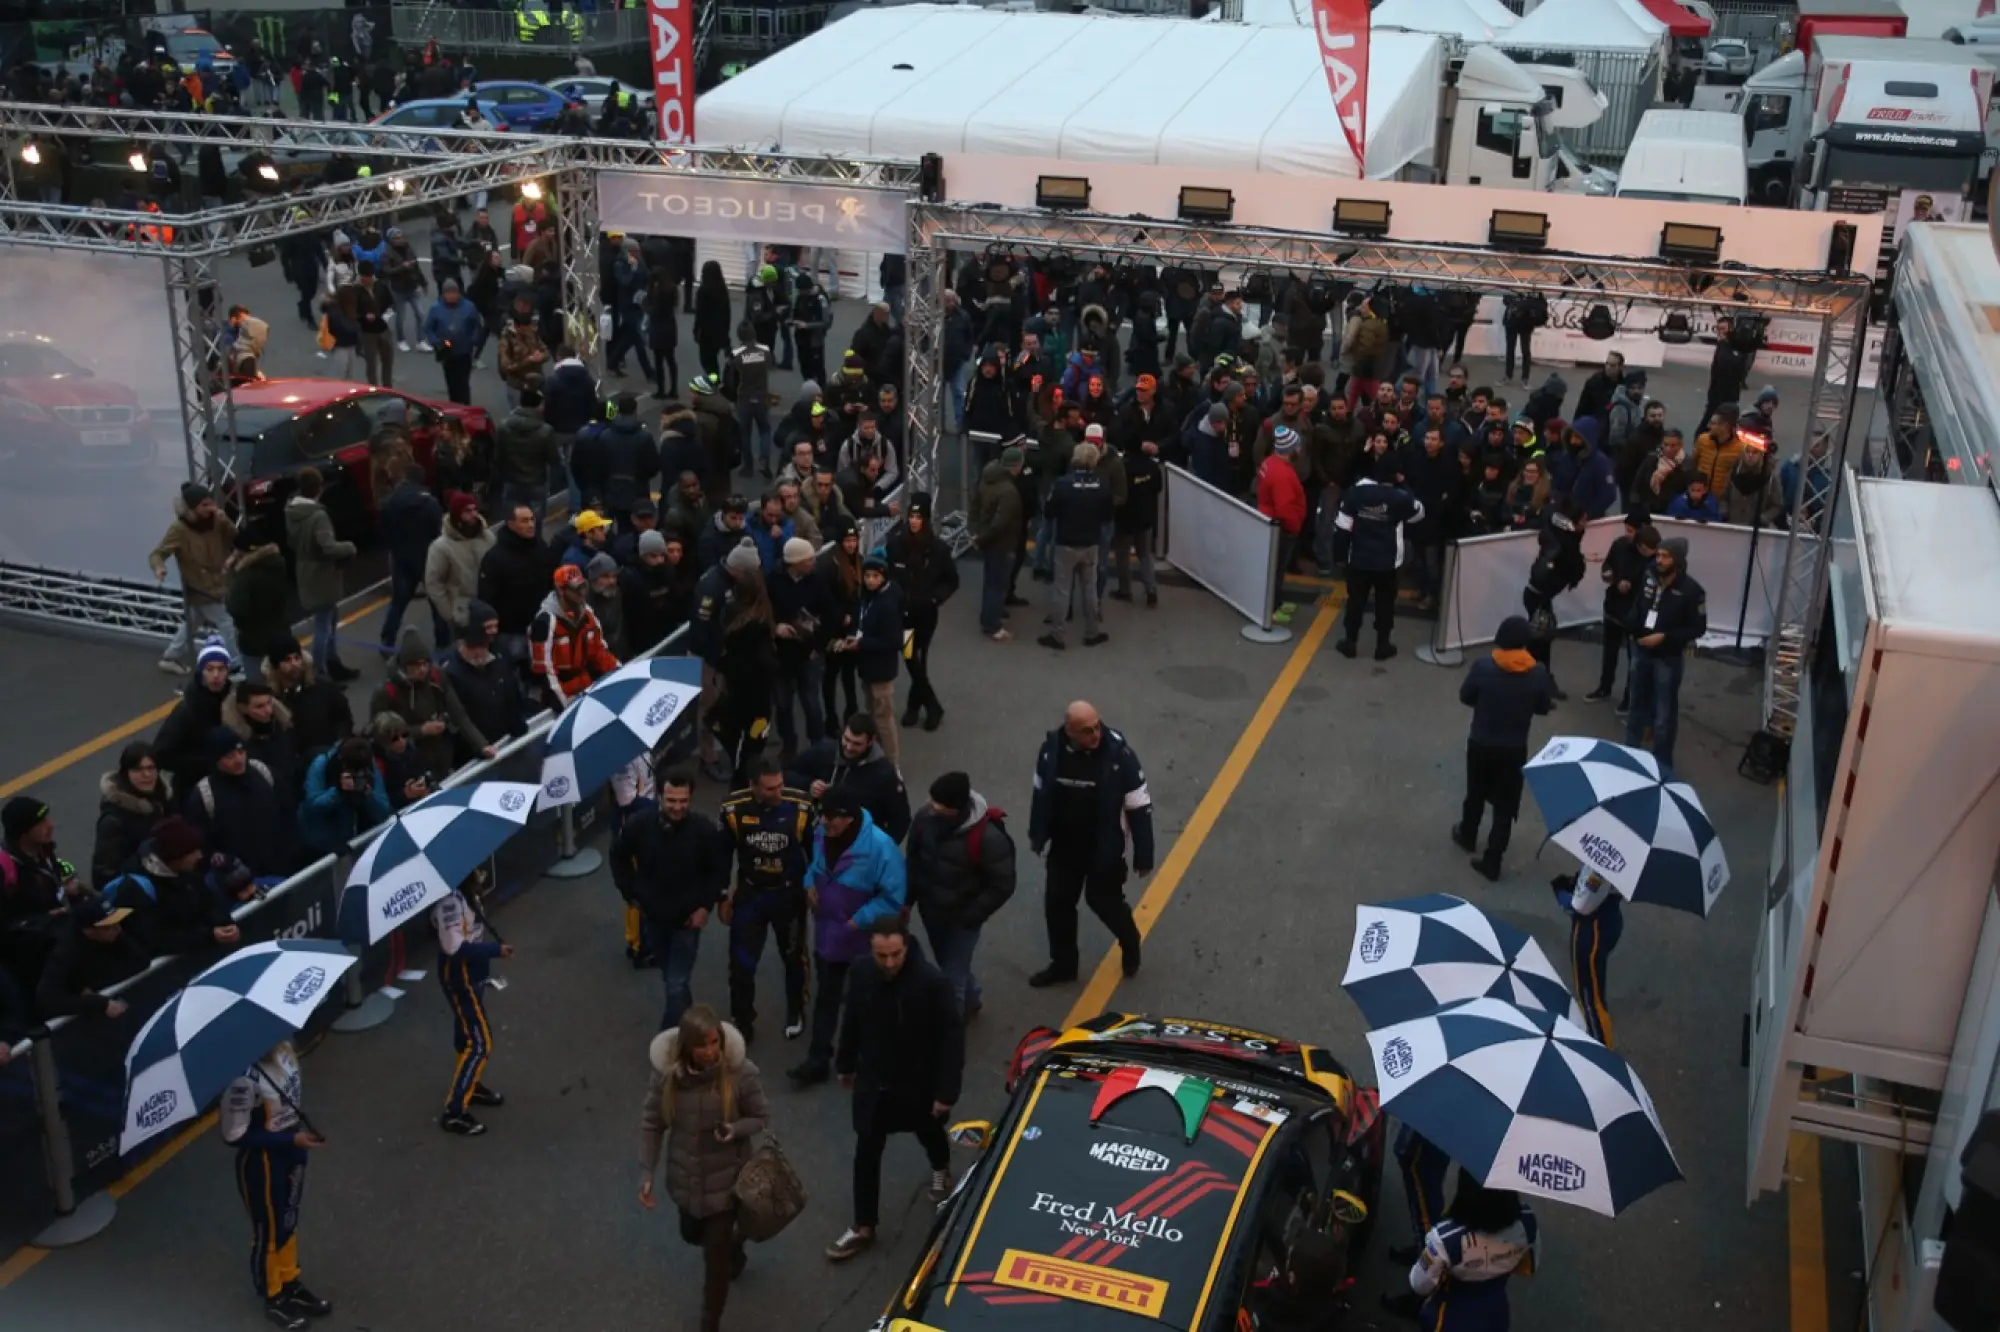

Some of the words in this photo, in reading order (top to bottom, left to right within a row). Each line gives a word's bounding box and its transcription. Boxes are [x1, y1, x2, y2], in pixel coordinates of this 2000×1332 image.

[1029, 1191, 1096, 1222] Fred
[1100, 1207, 1184, 1242] Mello
[1059, 1219, 1099, 1238] New
[1103, 1229, 1141, 1249] York
[1008, 1256, 1155, 1308] PIRELLI
